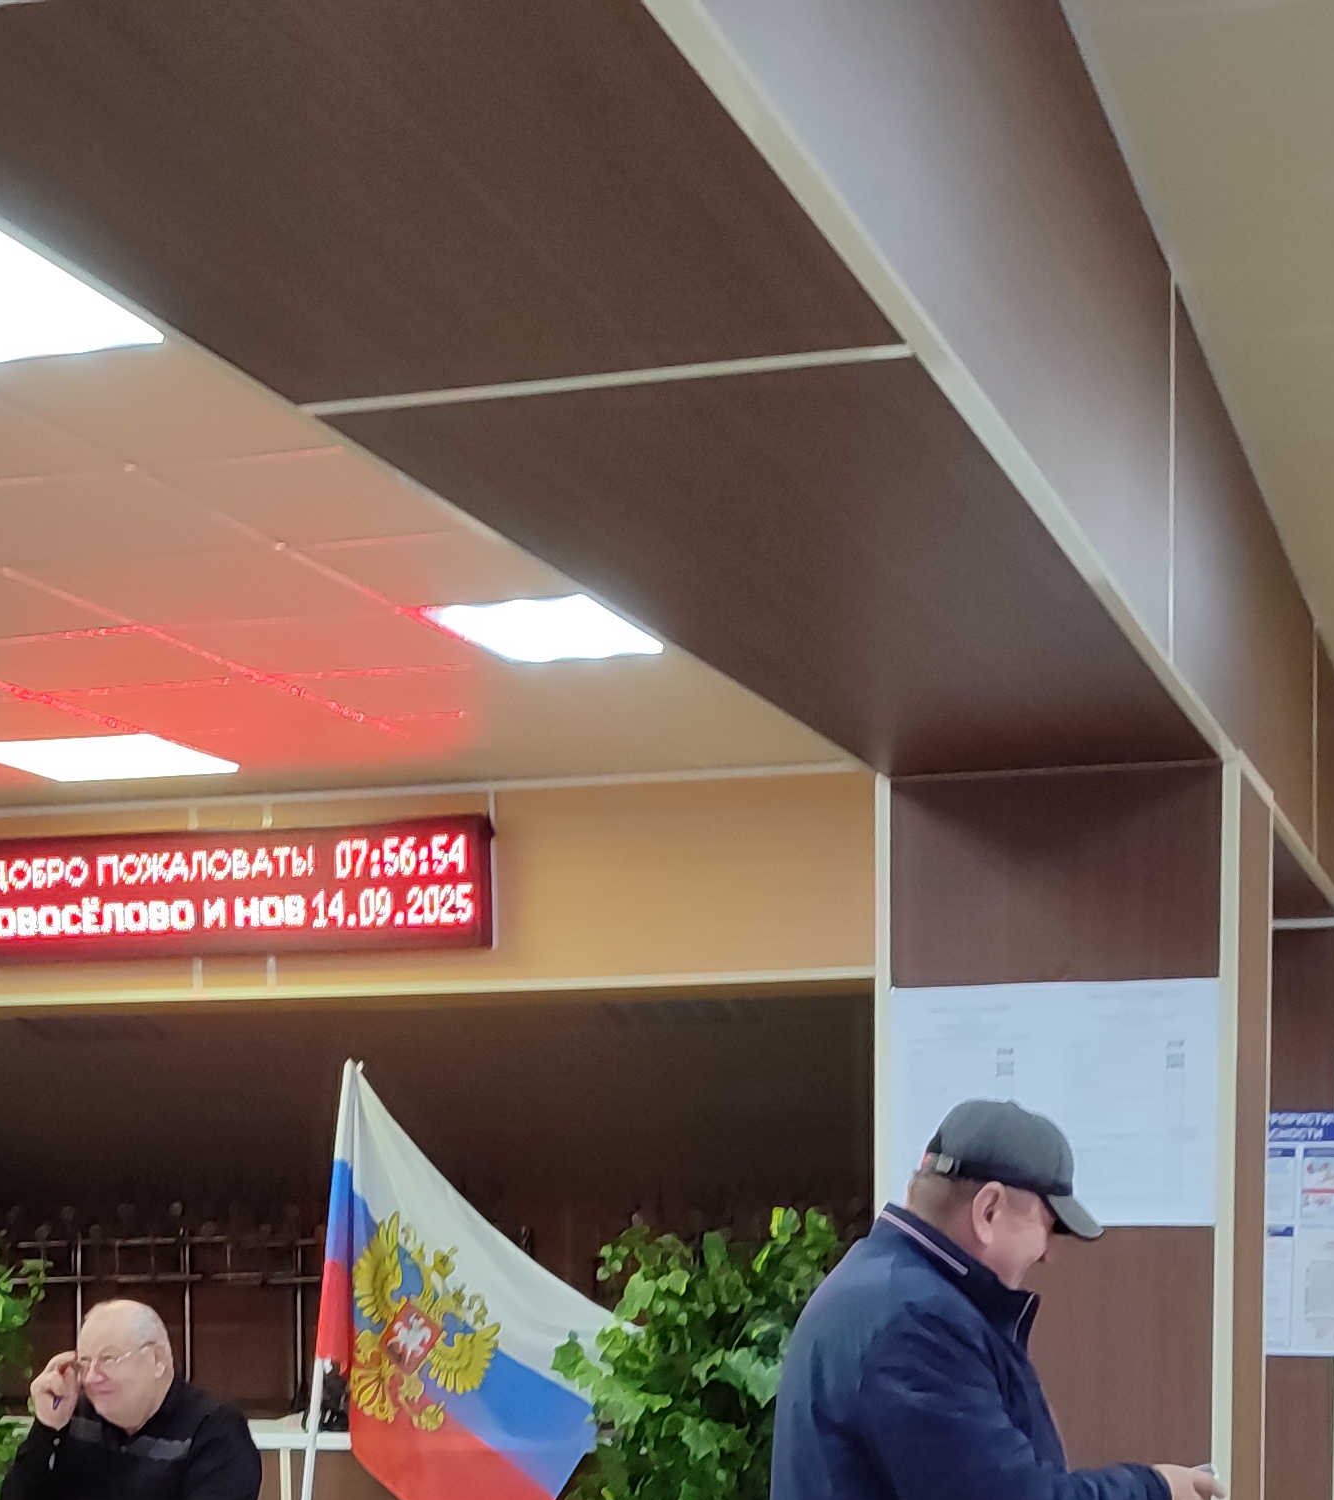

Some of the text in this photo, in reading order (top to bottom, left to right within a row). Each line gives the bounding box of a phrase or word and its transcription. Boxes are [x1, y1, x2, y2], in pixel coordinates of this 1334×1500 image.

[96, 844, 314, 887] ПОЖАЛОВАТЬ!
[334, 833, 466, 879] 07:56:54
[203, 896, 227, 930] И
[234, 894, 307, 928] НОВ
[312, 882, 474, 929] 14.09.2025
